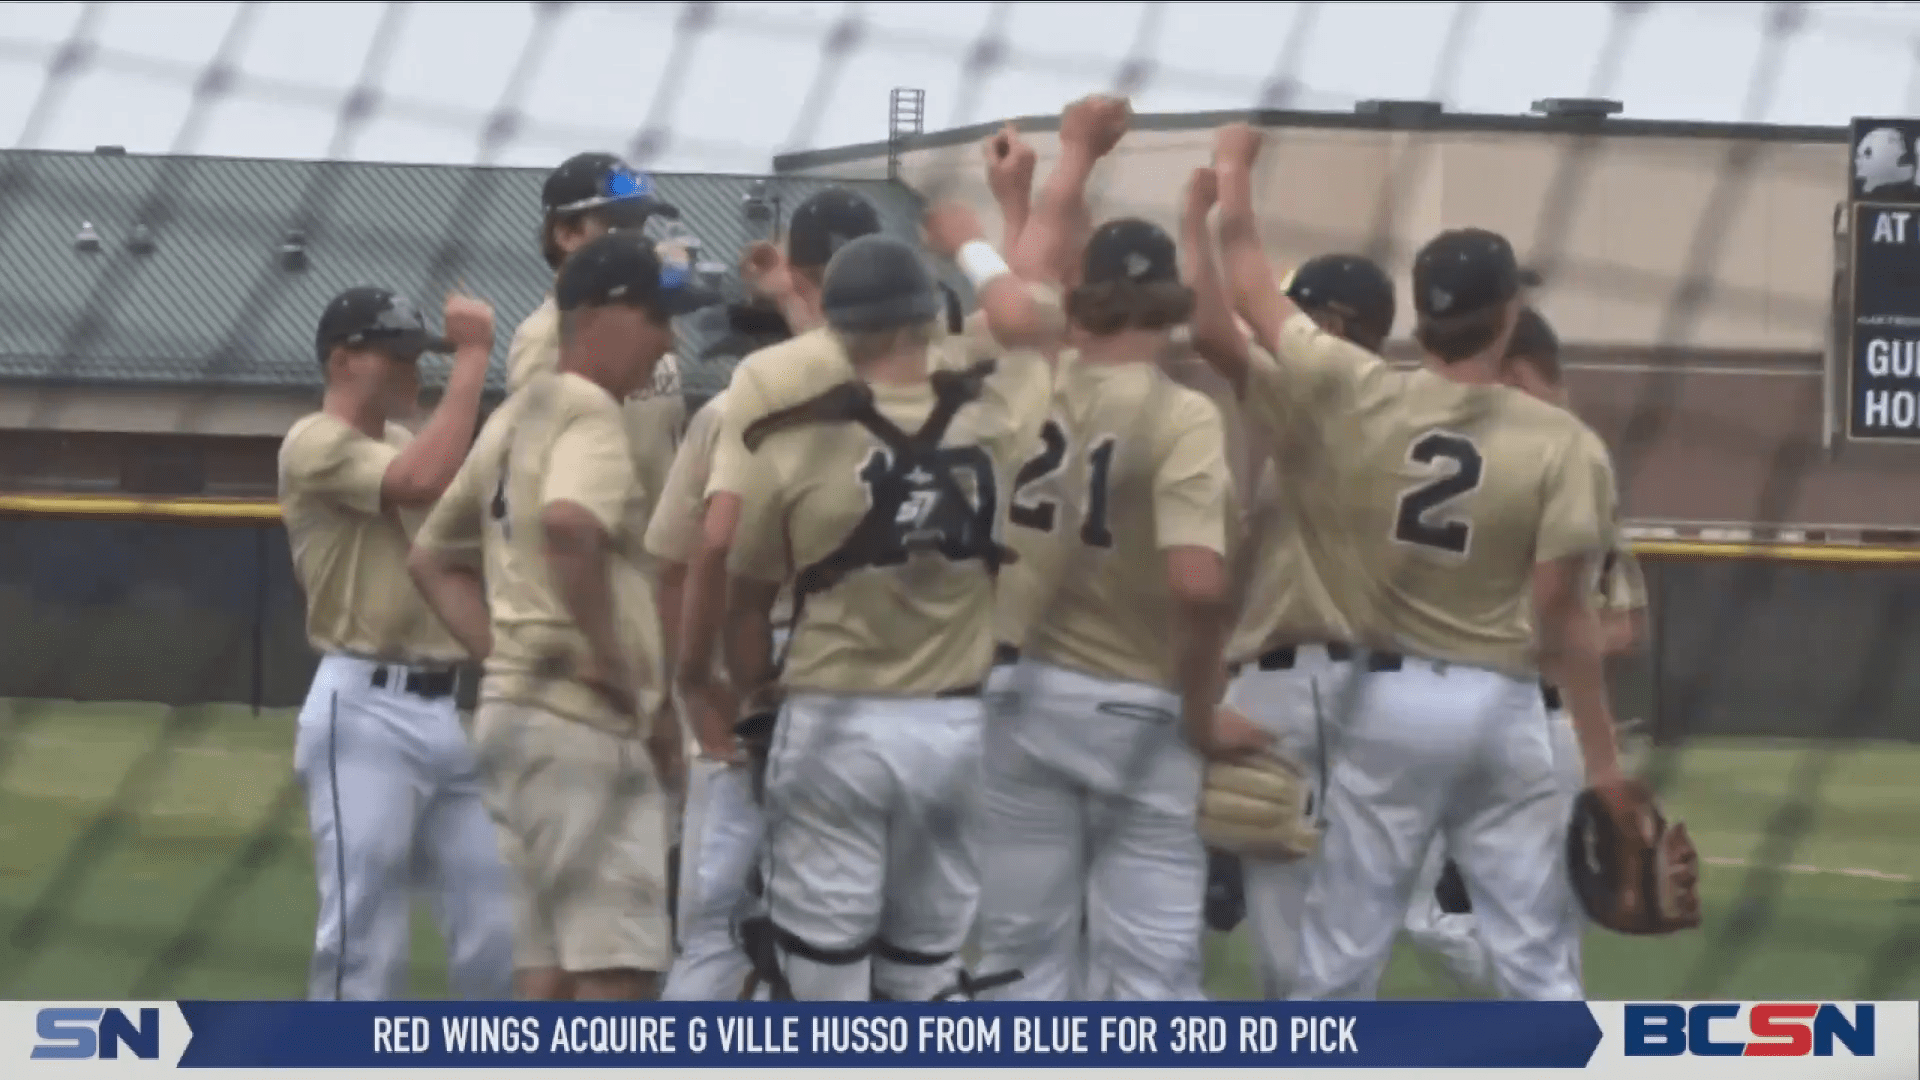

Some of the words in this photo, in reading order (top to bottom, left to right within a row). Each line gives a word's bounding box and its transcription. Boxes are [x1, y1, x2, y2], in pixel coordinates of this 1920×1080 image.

[1872, 211, 1911, 243] AT
[1866, 338, 1920, 378] GU
[1865, 389, 1920, 428] HO
[1006, 417, 1115, 549] 21
[1394, 432, 1484, 555] 2
